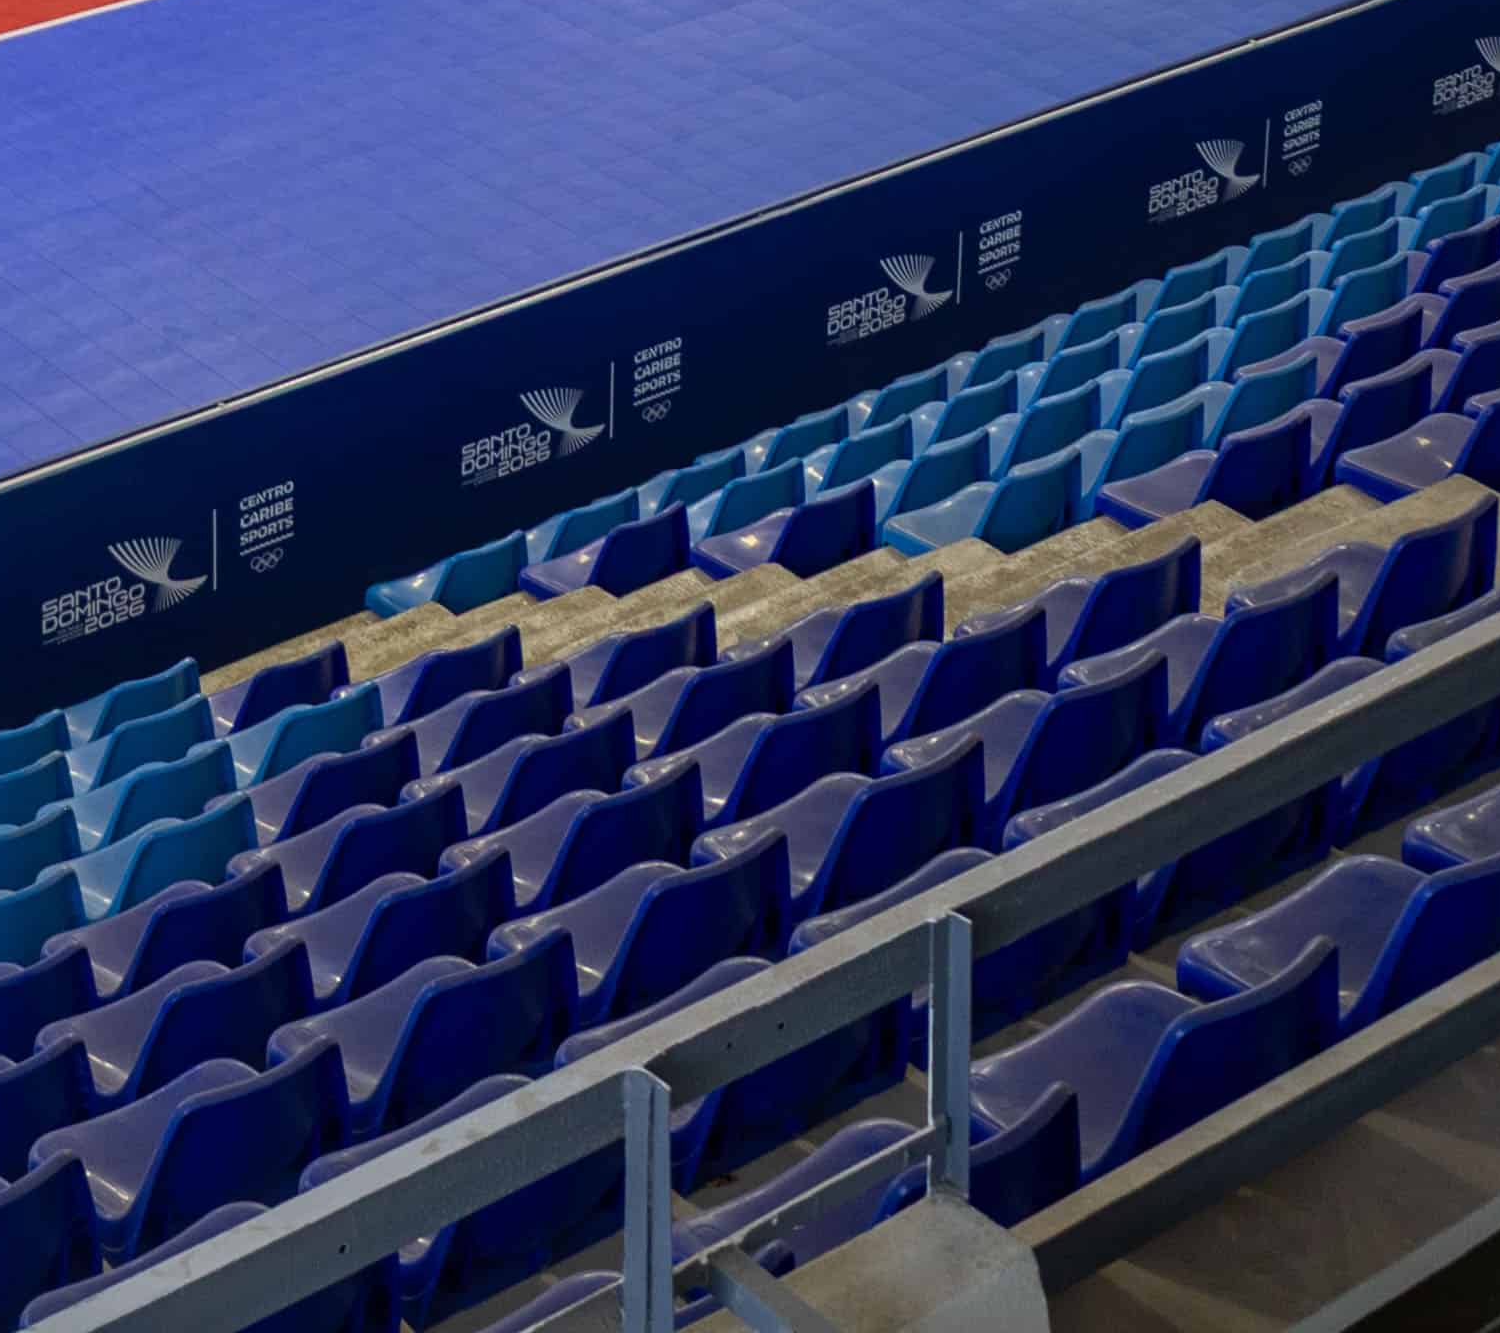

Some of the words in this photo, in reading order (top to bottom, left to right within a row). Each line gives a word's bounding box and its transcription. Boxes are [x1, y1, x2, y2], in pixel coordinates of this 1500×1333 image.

[1433, 72, 1494, 106] DOMINGO
[1434, 64, 1481, 92] SANTO
[1285, 99, 1323, 123] CENTRO
[1457, 84, 1494, 109] 2026
[1283, 129, 1321, 152] SPORTS
[1284, 113, 1322, 137] CARIBE
[1148, 176, 1218, 214] DOMINGO
[1150, 168, 1203, 199] SANTO
[1176, 189, 1218, 216] 2026
[979, 223, 1022, 250] CARIBE
[980, 209, 1022, 235] CENTRO
[979, 241, 1021, 266] SPORTS
[827, 294, 905, 336] DOMINGO
[828, 286, 888, 321] SANTO
[859, 308, 905, 338] 2026
[634, 336, 682, 365] CENTRO
[634, 351, 682, 381] CARIBE
[634, 369, 682, 397] SPORTS
[461, 430, 550, 477] DOMINGO
[462, 422, 530, 460] SANTO
[497, 444, 551, 477] 2026
[239, 480, 294, 511] CENTRO
[239, 496, 295, 529] CARIBE
[240, 515, 295, 546] SPORTS
[42, 575, 121, 618] SANTO
[42, 583, 145, 635] DOMINGO
[84, 598, 145, 635] 2026
